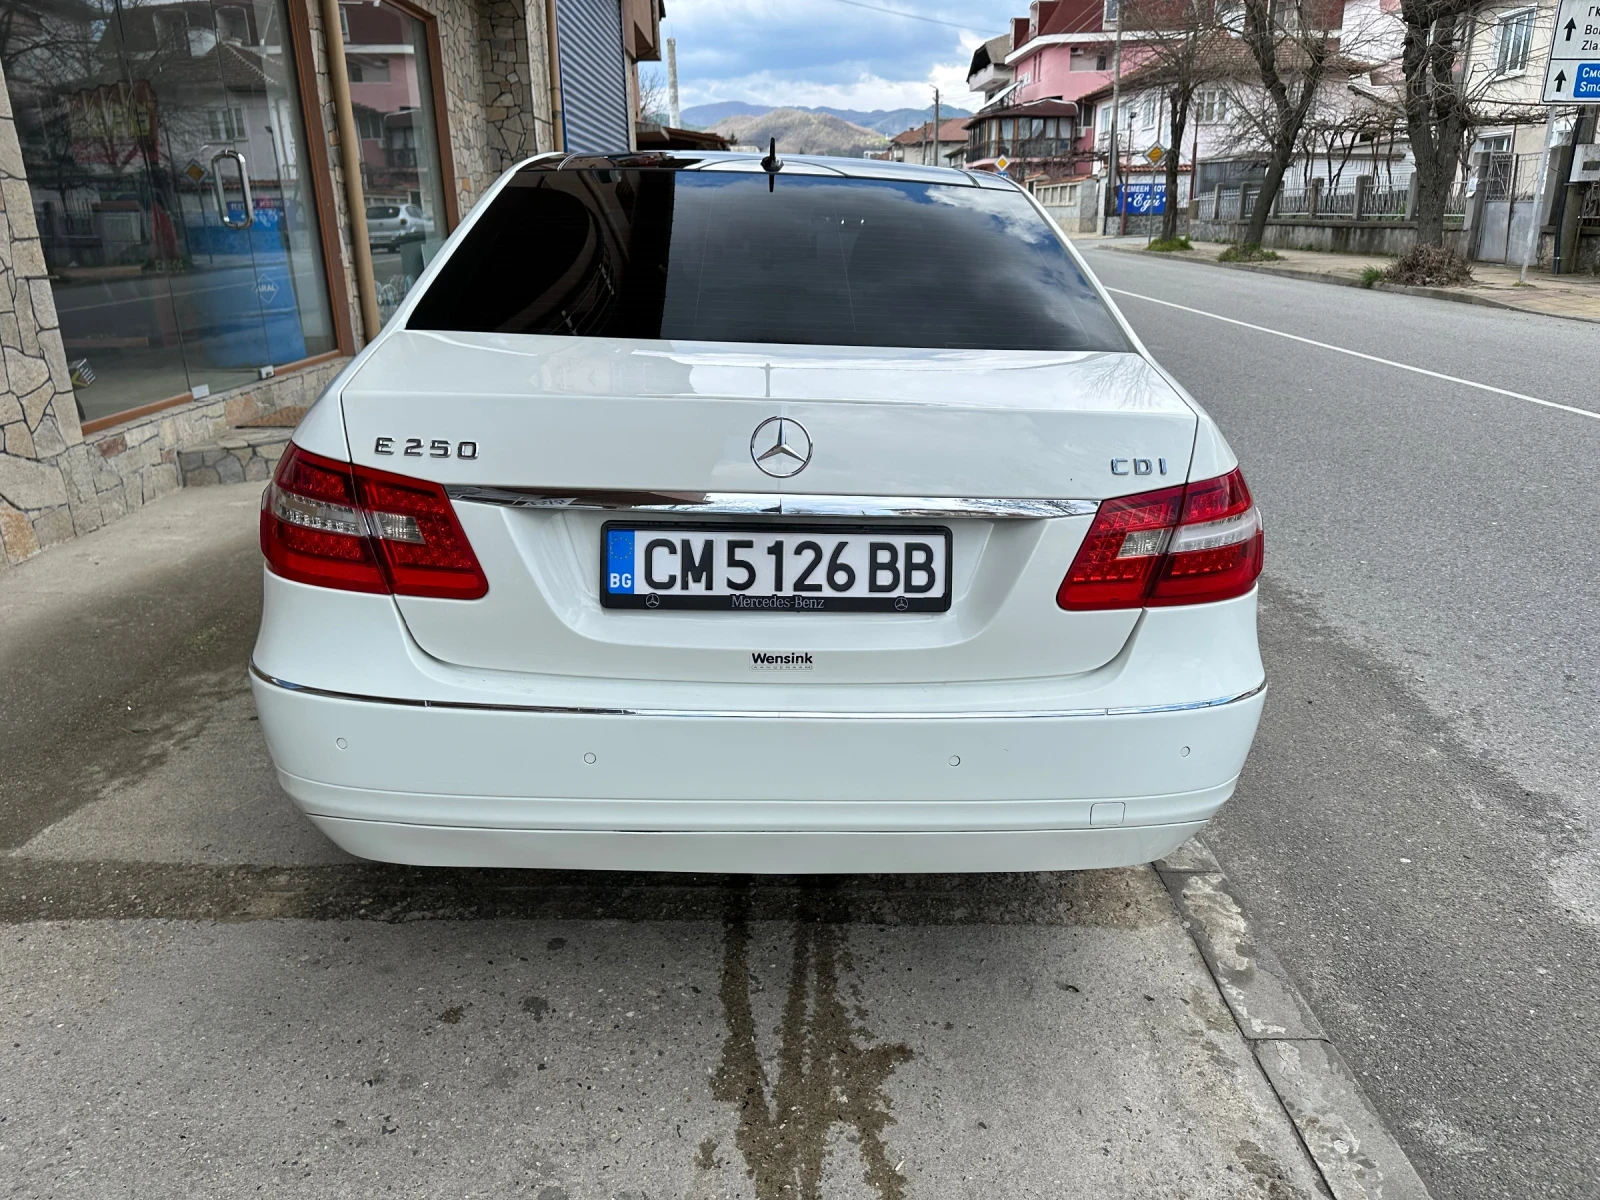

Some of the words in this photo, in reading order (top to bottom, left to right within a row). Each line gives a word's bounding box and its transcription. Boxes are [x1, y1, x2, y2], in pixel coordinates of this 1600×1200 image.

[1584, 24, 1600, 35] Bo
[1581, 40, 1600, 51] Zla
[374, 436, 396, 456] E
[403, 438, 480, 461] 250
[1110, 457, 1168, 475] CDI
[609, 573, 632, 588] BG
[731, 595, 825, 609] Mercedes-Benz
[751, 652, 813, 664] Wensink
